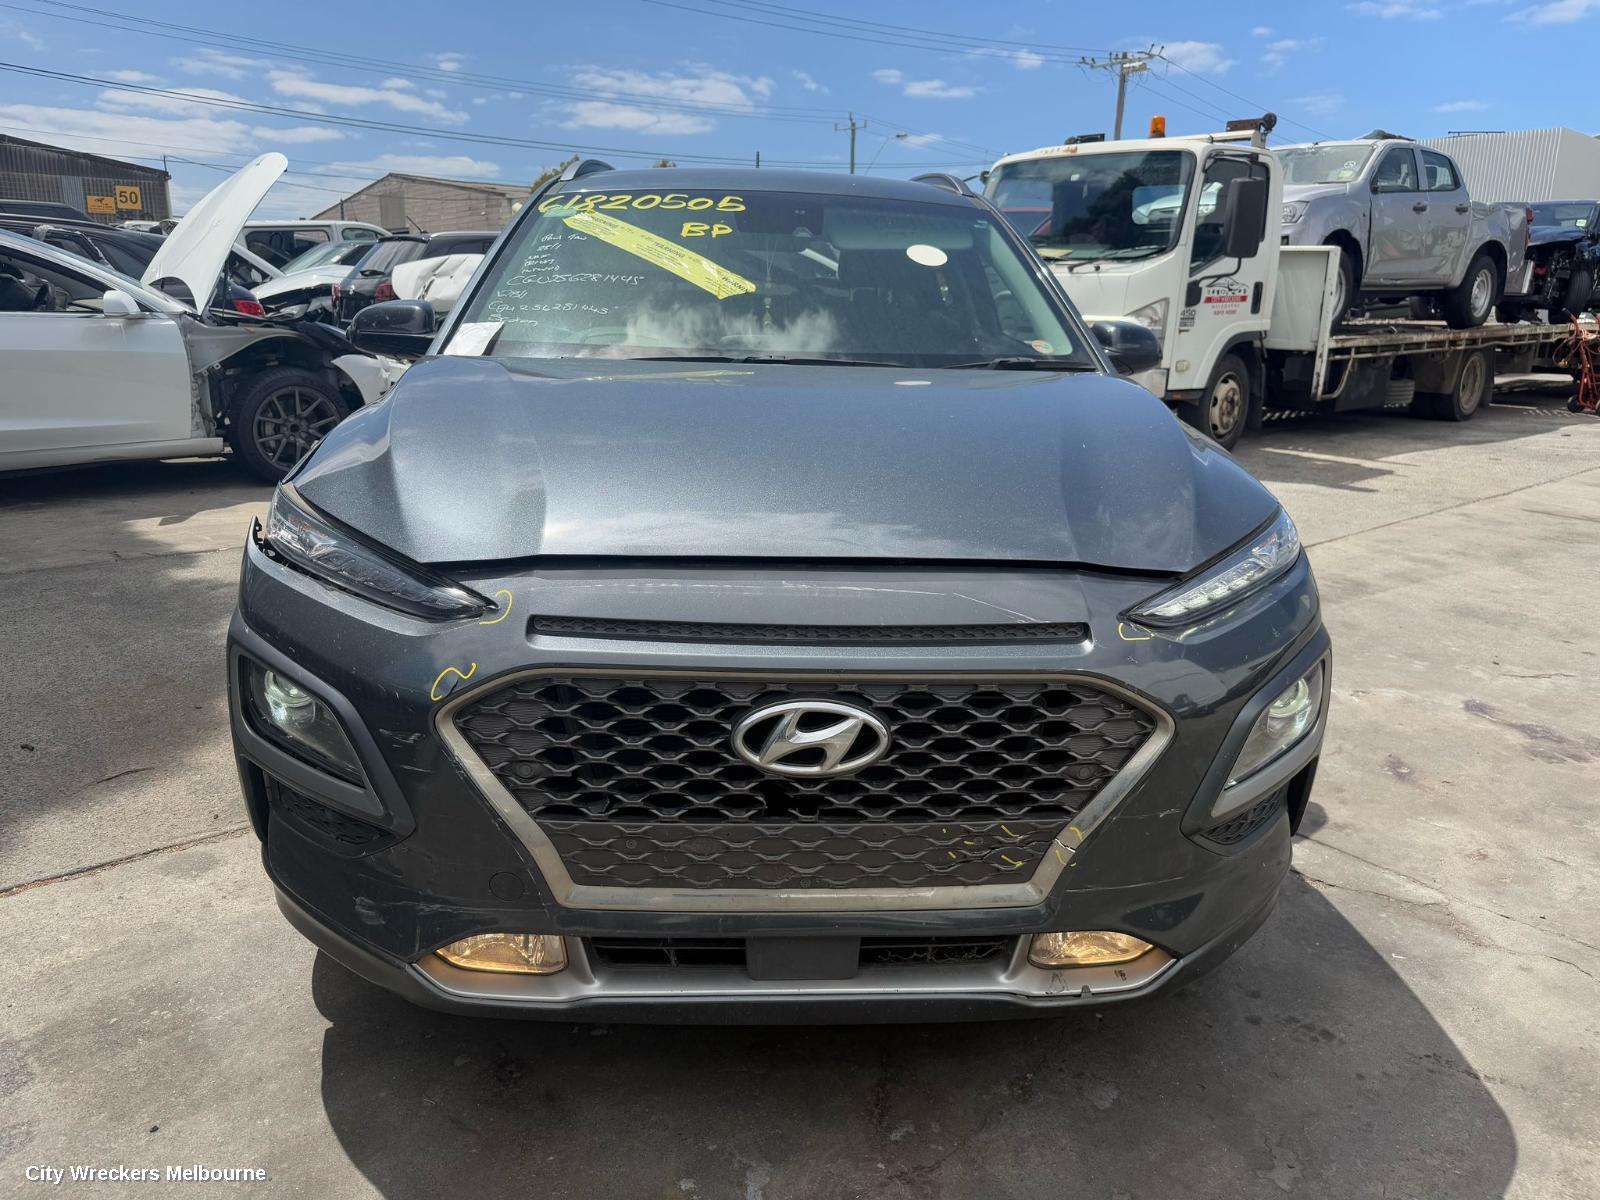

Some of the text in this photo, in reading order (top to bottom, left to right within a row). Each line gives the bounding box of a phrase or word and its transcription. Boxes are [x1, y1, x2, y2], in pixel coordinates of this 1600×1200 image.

[119, 191, 138, 204] 50
[681, 223, 732, 238] BP
[652, 241, 686, 258] WARNING
